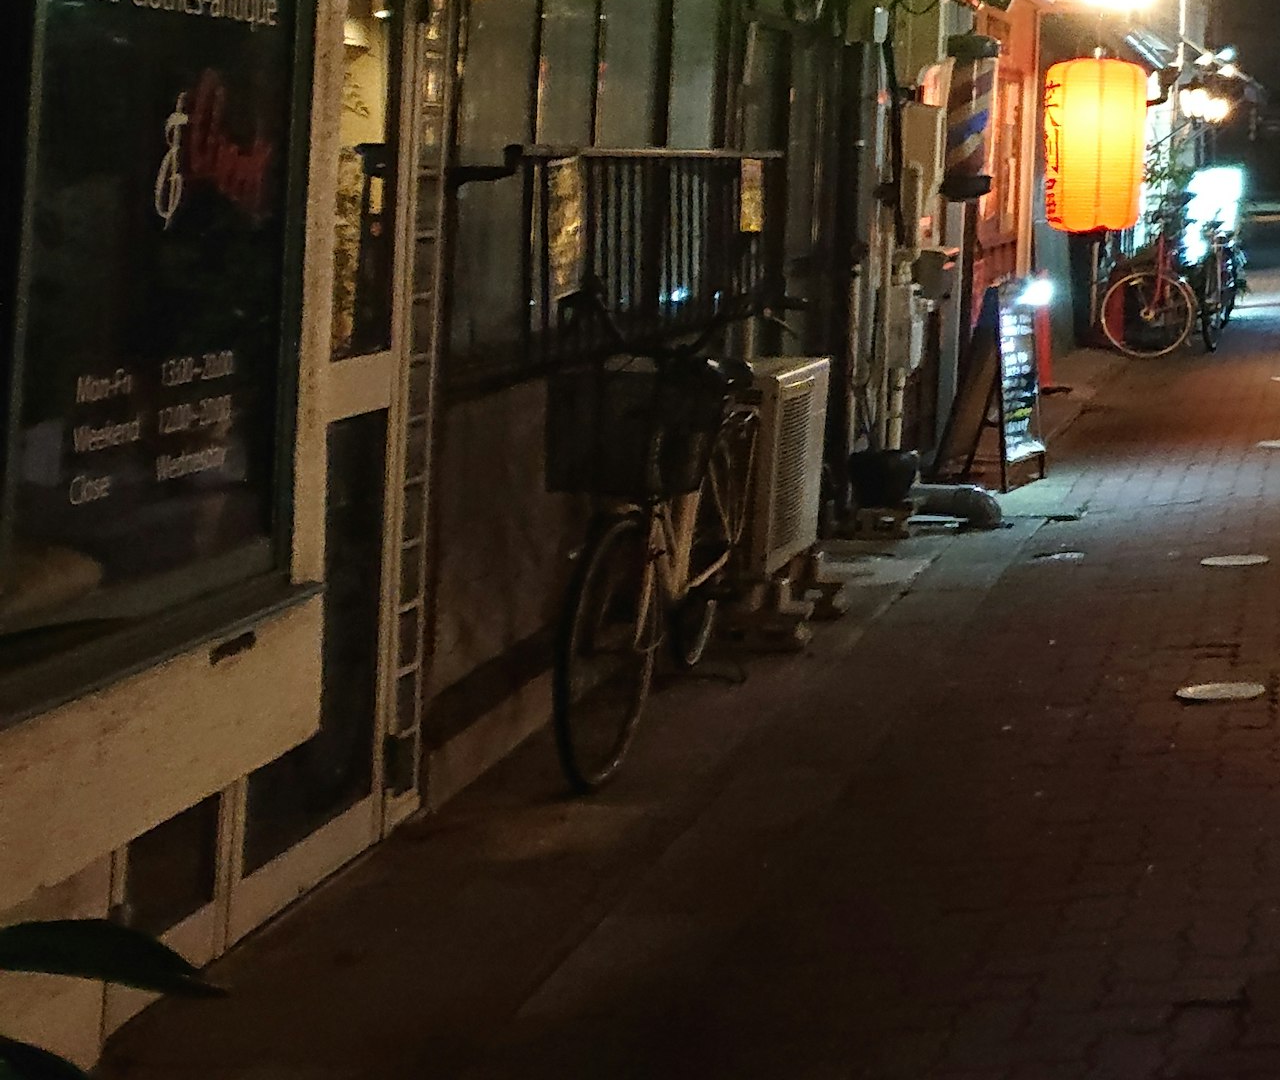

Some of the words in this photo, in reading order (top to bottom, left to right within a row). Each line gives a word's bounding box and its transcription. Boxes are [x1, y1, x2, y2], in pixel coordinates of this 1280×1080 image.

[76, 368, 134, 404] Mon-Fri
[73, 414, 144, 453] Weekend
[69, 475, 113, 505] Close
[156, 444, 227, 482] Wednesday
